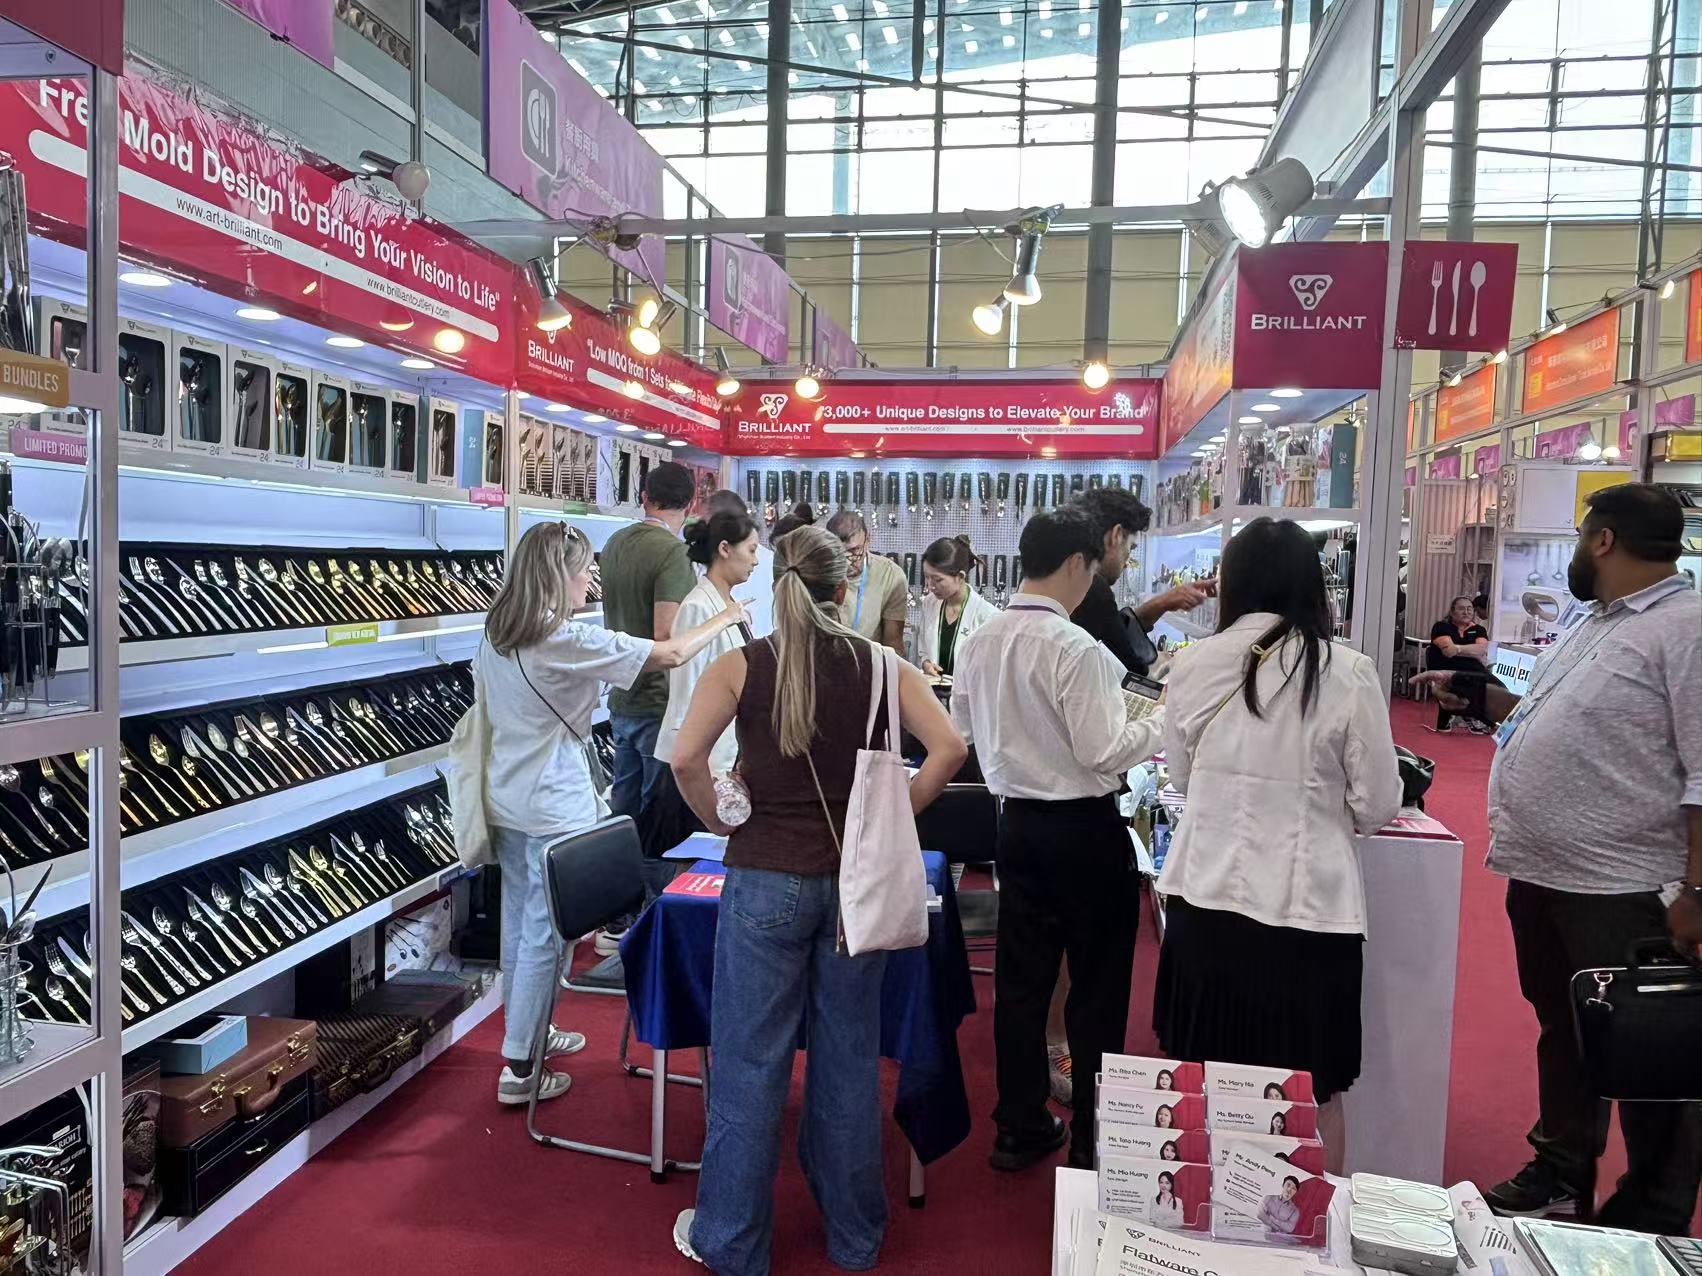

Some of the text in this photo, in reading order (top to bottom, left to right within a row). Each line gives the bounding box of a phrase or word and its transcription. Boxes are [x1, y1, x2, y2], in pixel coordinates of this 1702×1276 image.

[124, 110, 193, 174] Mold
[203, 147, 283, 216] Design
[290, 192, 310, 226] to
[316, 203, 366, 259] Bring
[370, 230, 406, 270] Your
[410, 249, 454, 292] Vision
[457, 274, 470, 300] to
[176, 197, 283, 251] www.art-brilliant.com
[1250, 313, 1368, 330] BRILLIANT
[528, 339, 575, 372] BRILLIANT
[608, 347, 627, 373] MOQ
[627, 357, 644, 379] from
[645, 366, 649, 381] 1
[650, 367, 665, 389] Sets
[3, 364, 60, 393] BUNDLES
[876, 405, 925, 420] Unique
[928, 405, 985, 421] Designs
[988, 406, 1003, 419] to
[1007, 405, 1060, 419] Elevate
[1063, 405, 1096, 419] Your
[738, 420, 812, 433] BRILLIANT
[24, 437, 58, 455] LIMITED
[152, 438, 164, 449] 24
[209, 445, 220, 456] 24
[259, 453, 269, 463] 24
[1132, 1138, 1152, 1148] Huang
[1245, 1158, 1261, 1169] Andy
[1129, 1171, 1149, 1179] Huang
[1148, 1237, 1201, 1257] BRILLIANT
[1122, 1244, 1199, 1276] Flatware
